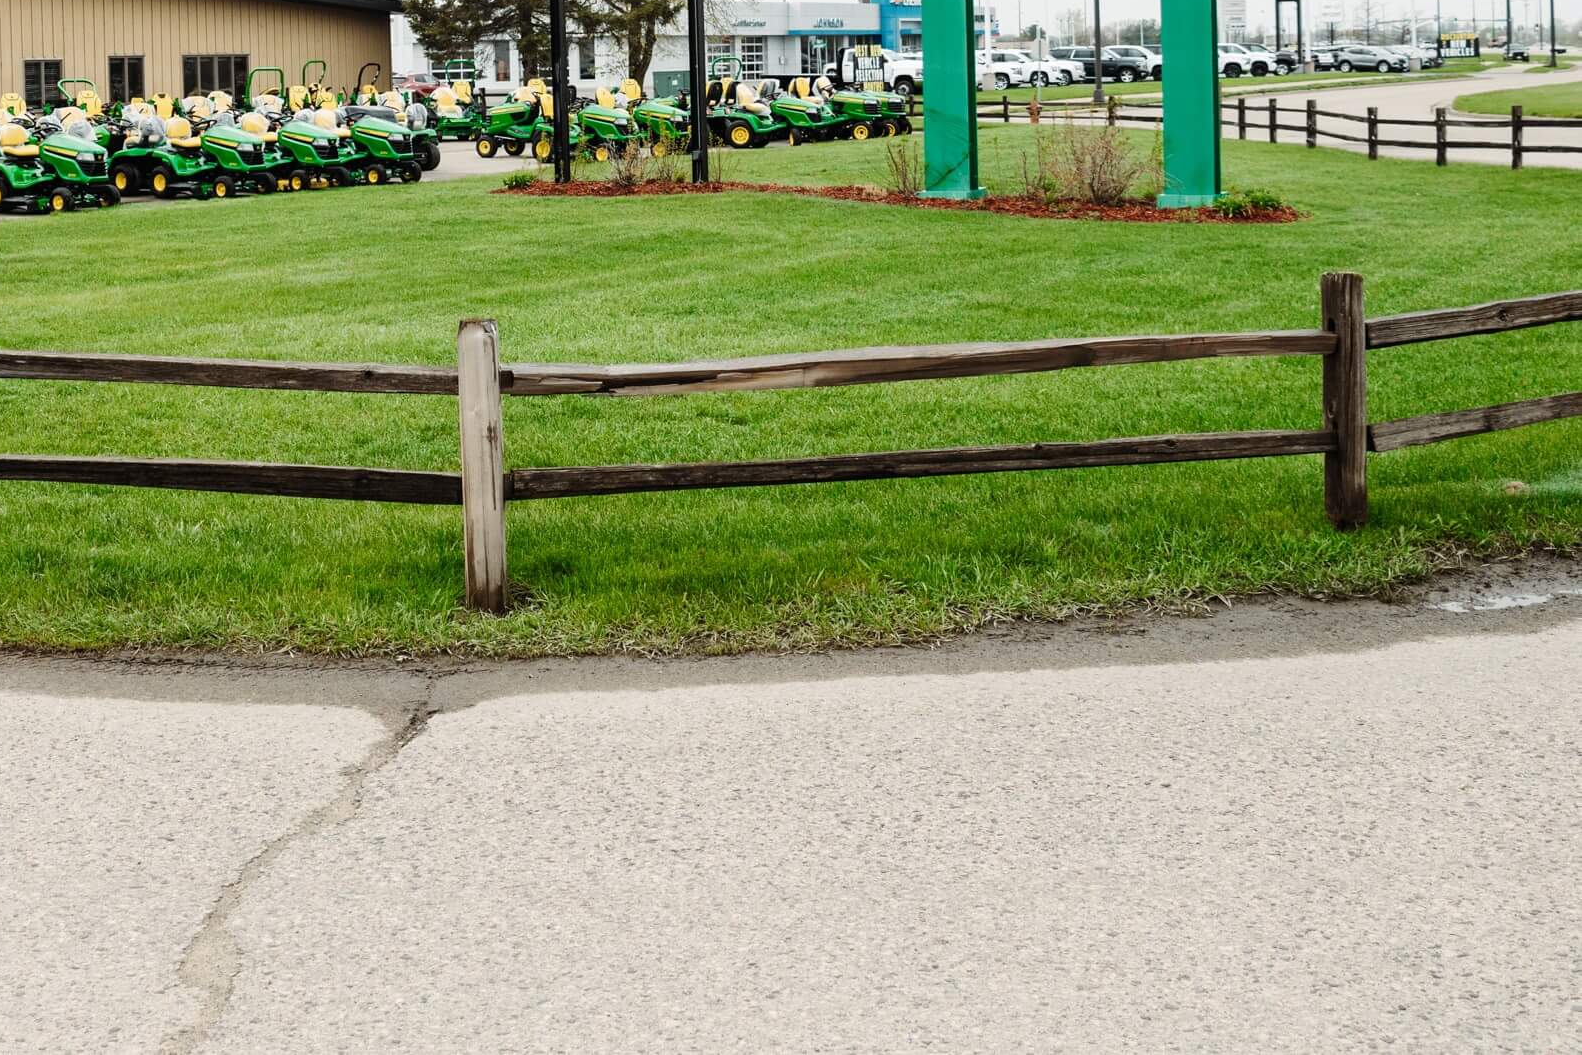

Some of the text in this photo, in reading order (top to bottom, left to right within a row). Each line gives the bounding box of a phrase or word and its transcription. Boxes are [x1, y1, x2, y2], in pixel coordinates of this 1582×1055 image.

[1440, 48, 1475, 57] VEHICLES
[857, 57, 880, 69] VEHICLE
[855, 69, 883, 82] SELECTION
